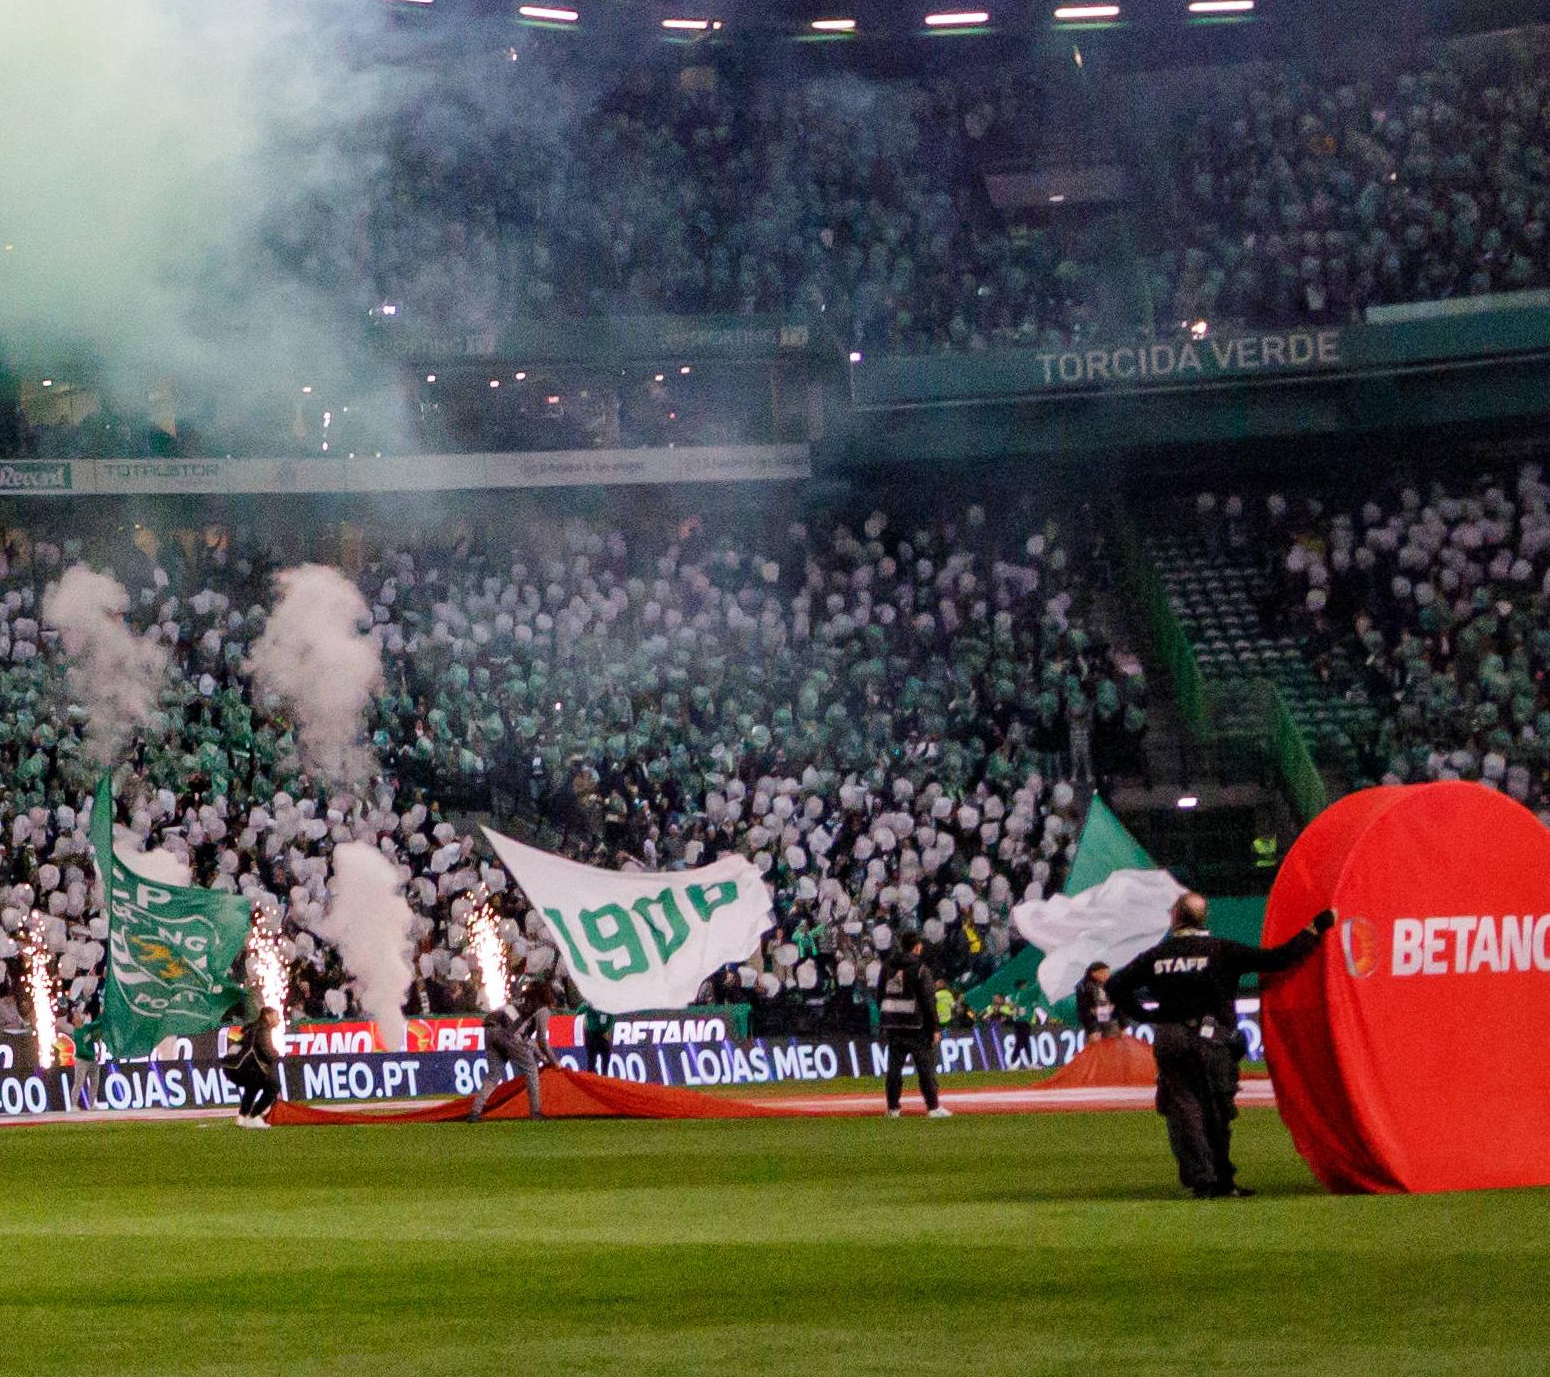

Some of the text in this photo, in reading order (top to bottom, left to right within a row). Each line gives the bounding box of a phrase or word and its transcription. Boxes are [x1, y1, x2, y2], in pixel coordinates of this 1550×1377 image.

[1035, 329, 1341, 386] TORCIDA VERDE
[1153, 955, 1209, 977] STAFF
[303, 1060, 420, 1101] MEO.PT
[680, 1044, 839, 1087] LOJAS MEO
